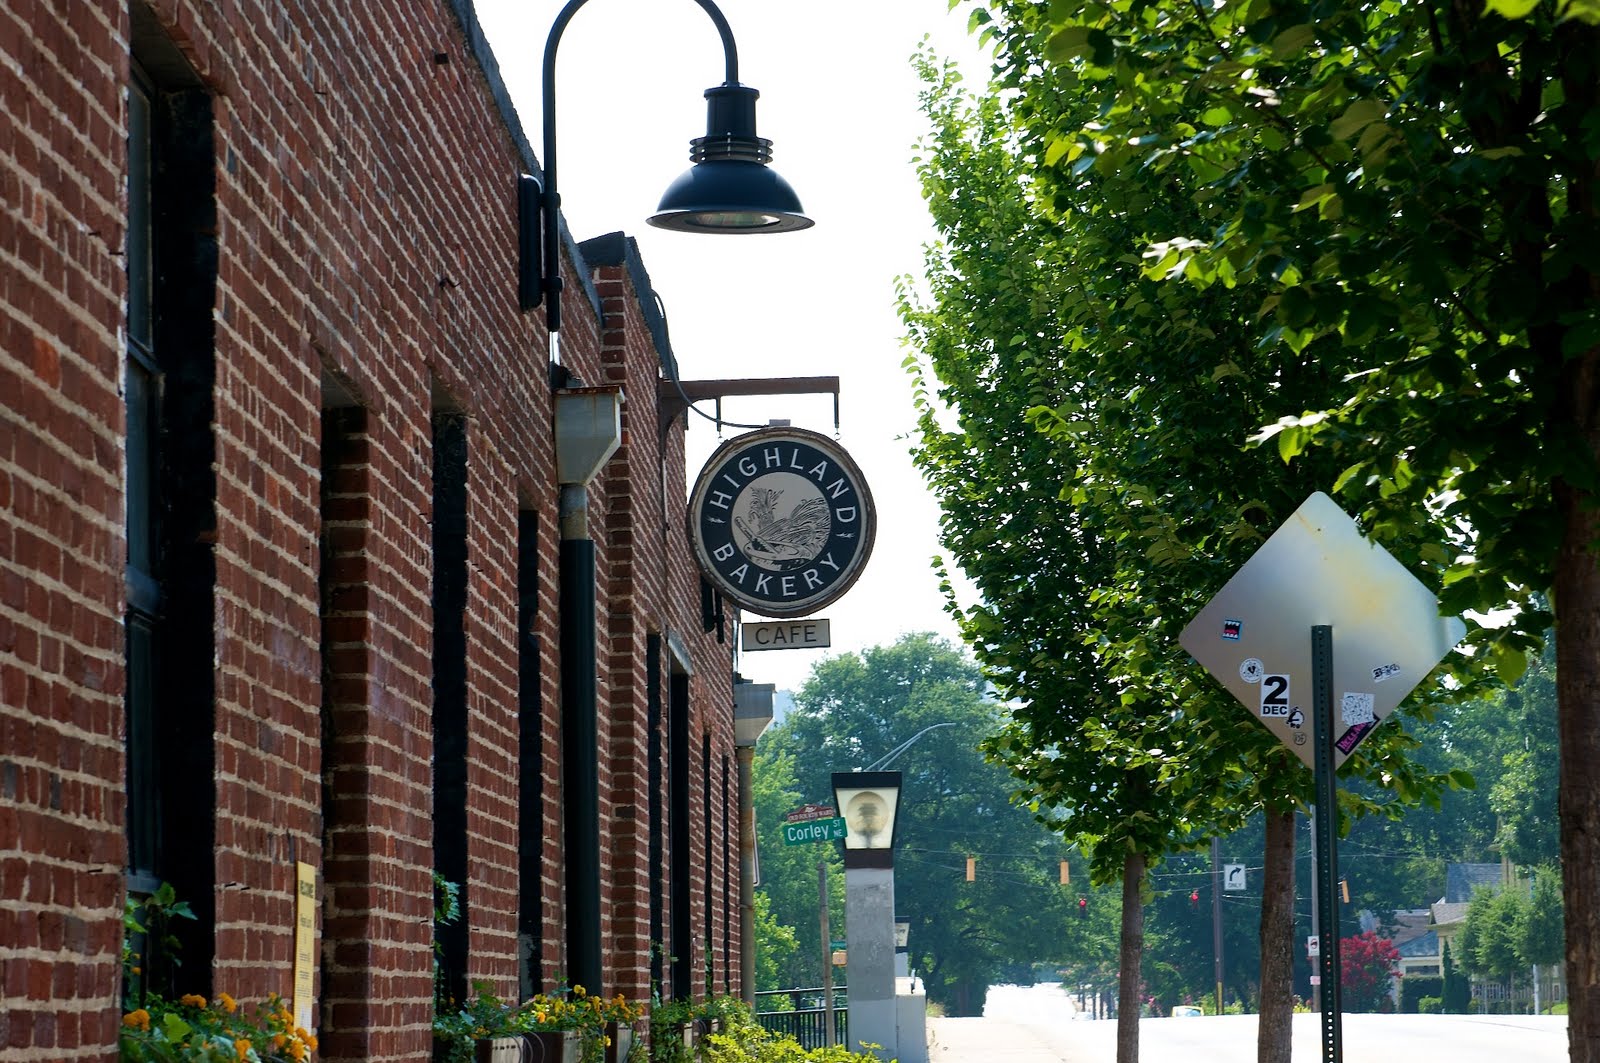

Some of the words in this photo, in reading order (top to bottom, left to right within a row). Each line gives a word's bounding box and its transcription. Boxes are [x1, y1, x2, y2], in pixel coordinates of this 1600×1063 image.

[709, 447, 857, 523] HIGHLAND
[713, 542, 841, 597] BAKERY
[755, 624, 817, 645] CAFE
[1263, 675, 1288, 705] 2
[1262, 705, 1288, 715] DEC
[787, 824, 829, 841] Corley
